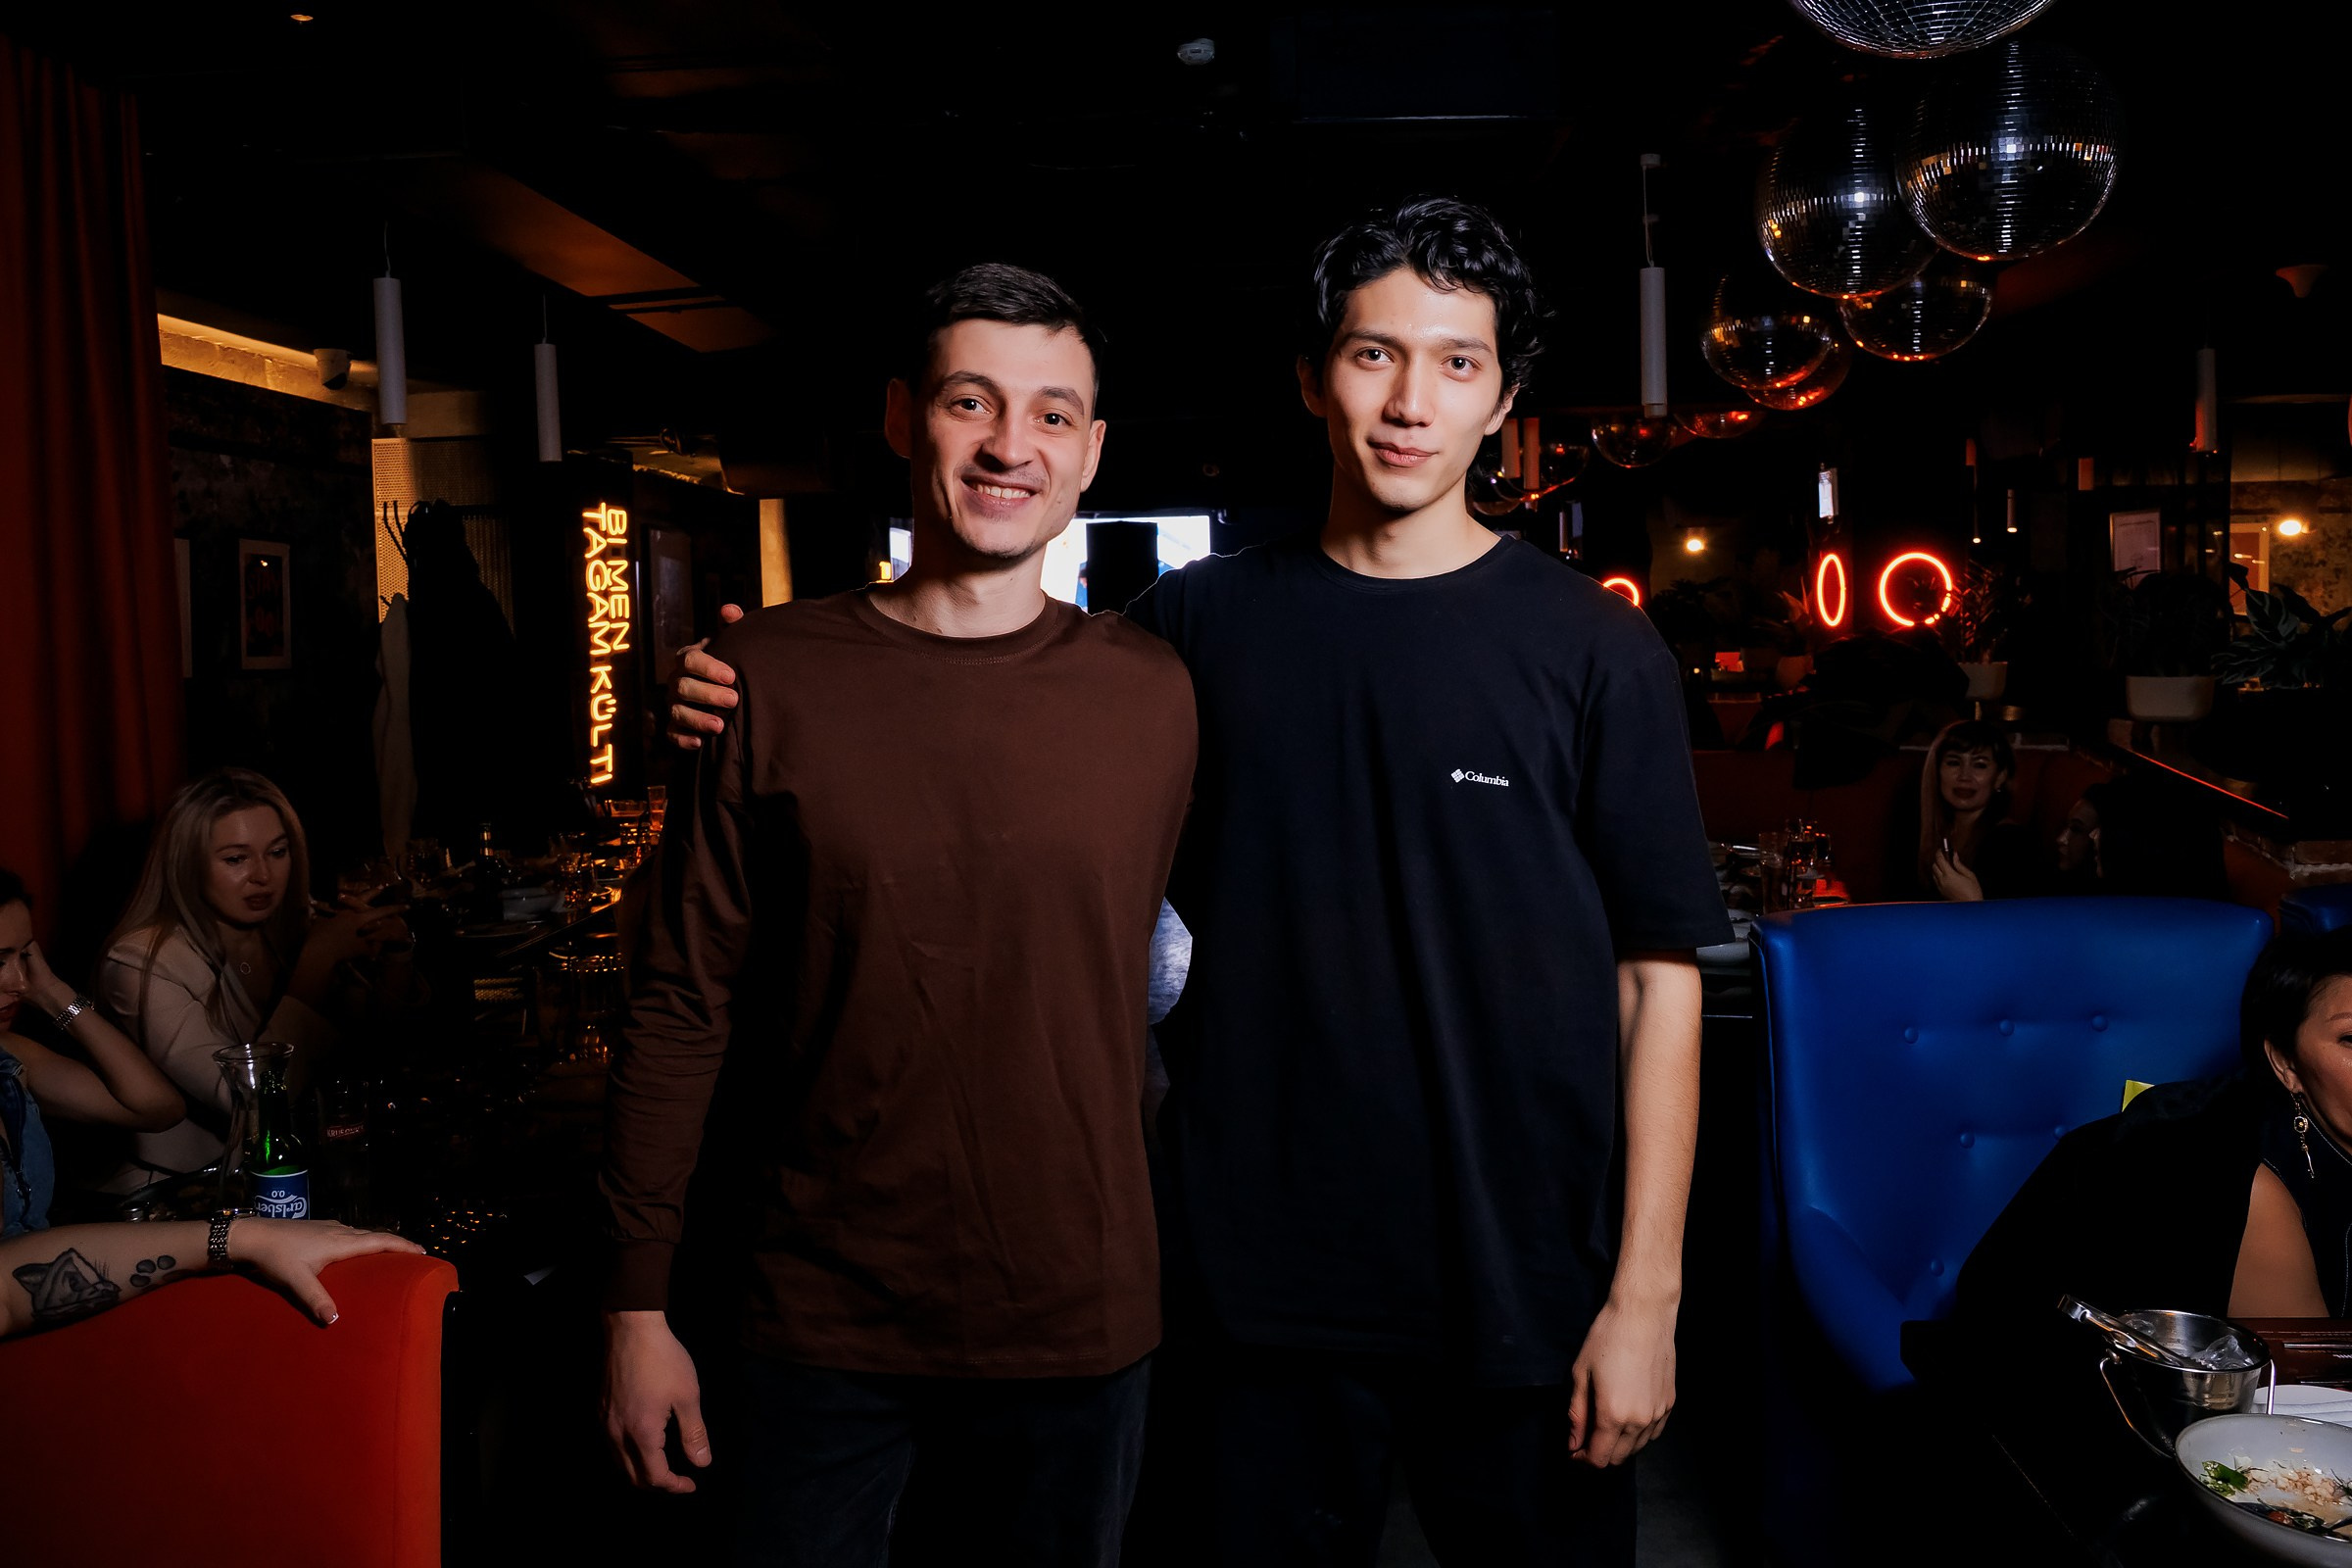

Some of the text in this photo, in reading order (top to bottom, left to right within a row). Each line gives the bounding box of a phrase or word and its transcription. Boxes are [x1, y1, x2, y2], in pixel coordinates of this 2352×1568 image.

[606, 508, 631, 651] BI MEN
[1464, 770, 1510, 787] Columbia
[270, 1190, 285, 1199] 0.0
